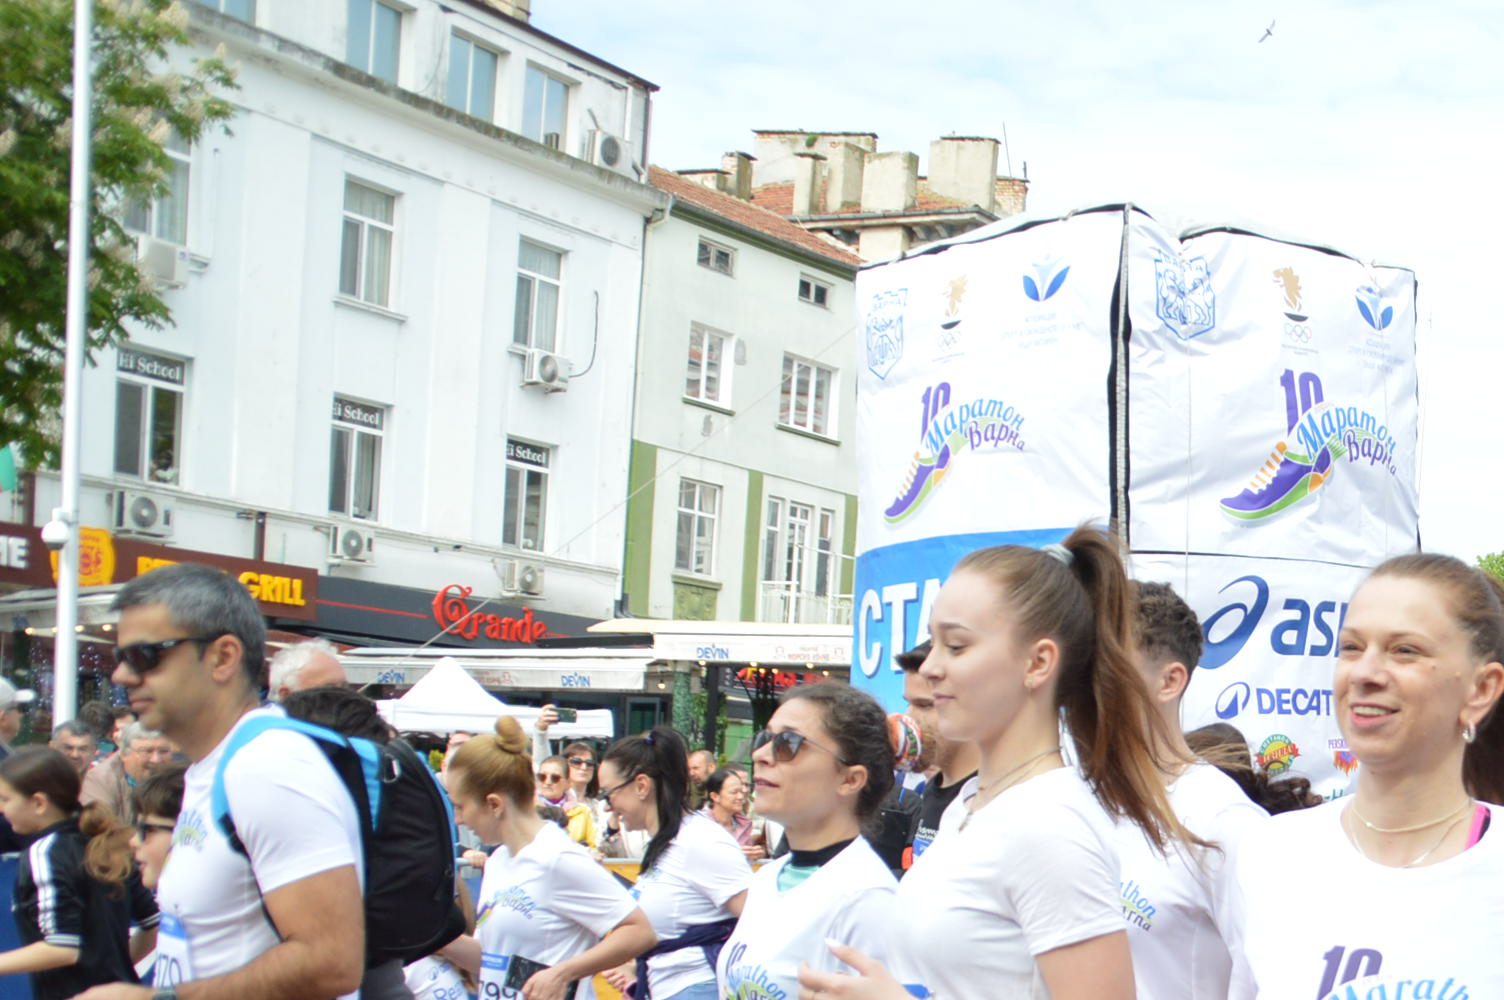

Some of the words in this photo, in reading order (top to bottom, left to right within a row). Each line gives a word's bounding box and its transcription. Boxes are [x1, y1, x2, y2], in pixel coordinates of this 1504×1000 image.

[138, 356, 182, 381] School
[344, 405, 380, 425] School
[925, 398, 1025, 461] Маратон
[965, 420, 1025, 451] Варна
[1297, 406, 1397, 461] Маратон
[515, 445, 547, 465] School
[239, 571, 306, 607] GRILL
[432, 584, 547, 644] Grande
[696, 644, 729, 659] DEVIN
[561, 672, 591, 688] DEVIN
